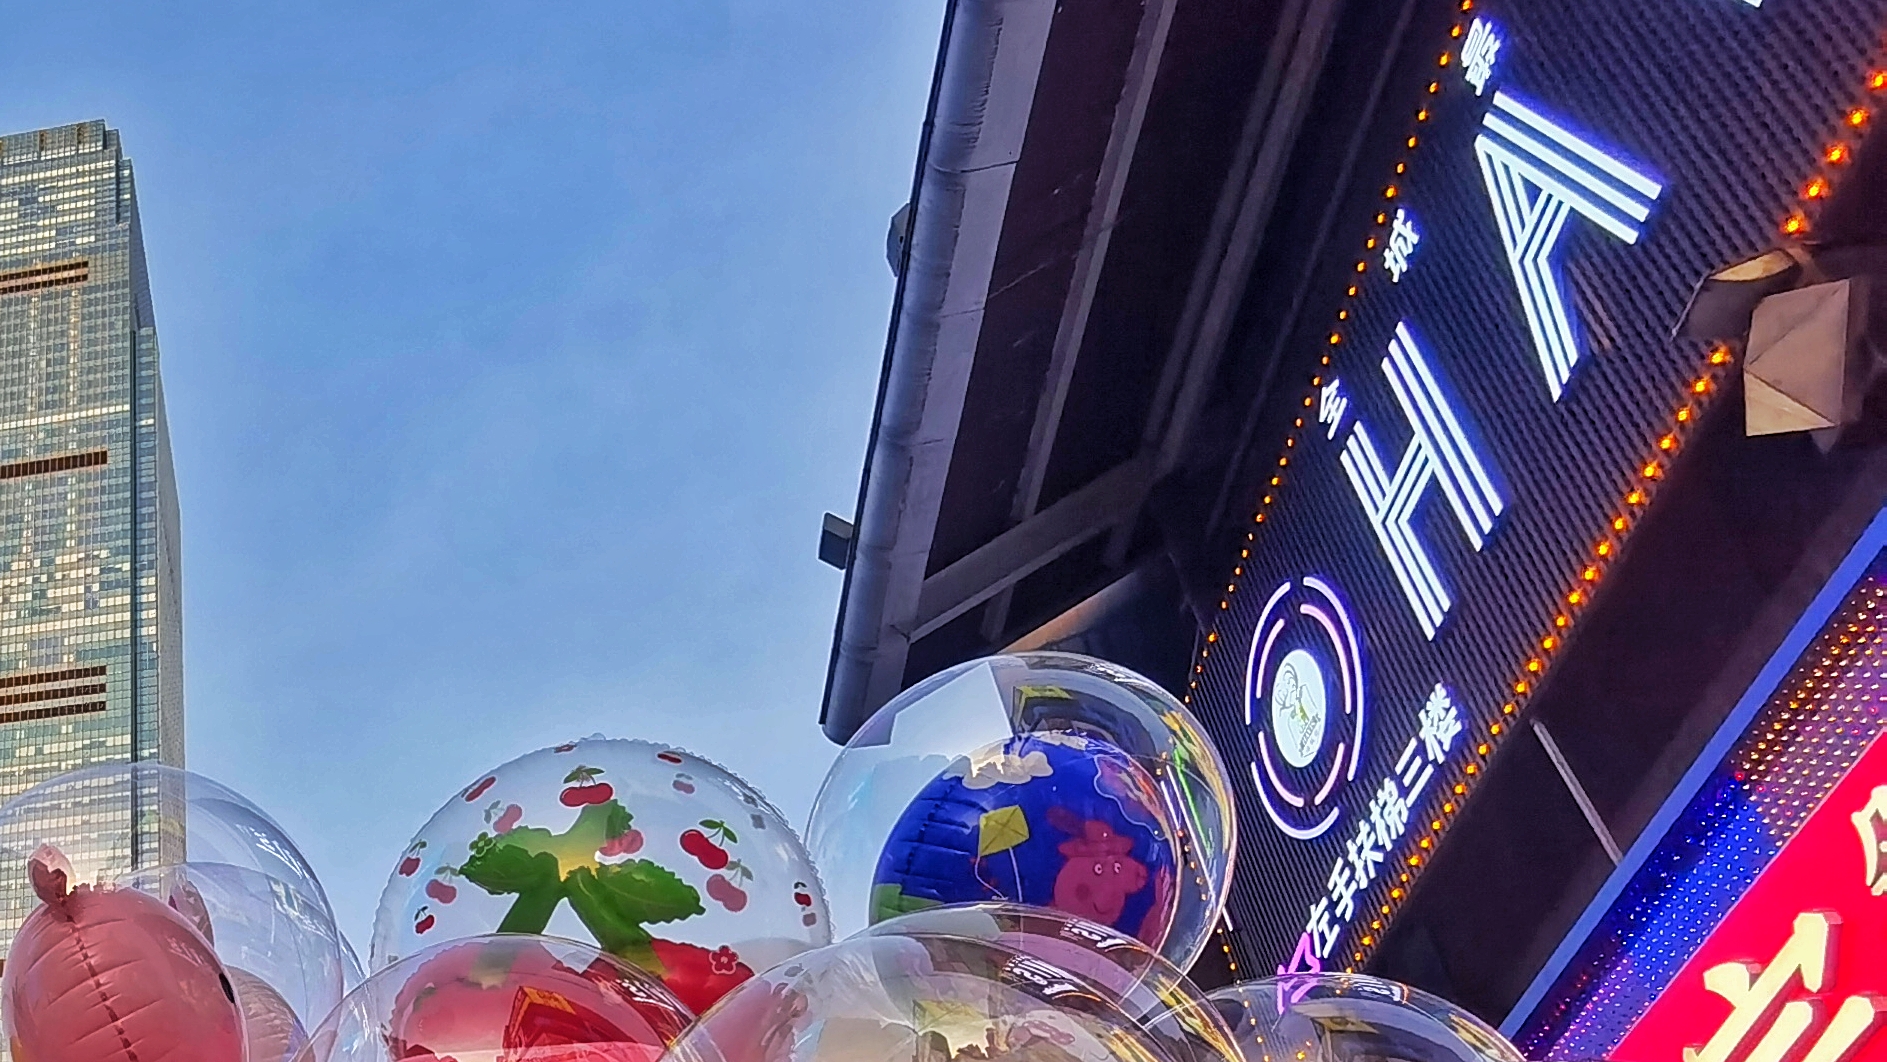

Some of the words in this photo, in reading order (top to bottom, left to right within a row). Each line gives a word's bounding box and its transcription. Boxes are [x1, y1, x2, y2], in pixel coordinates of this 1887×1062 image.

[1339, 90, 1664, 640] HA
[1306, 681, 1463, 959] 左手扶梯三楼
